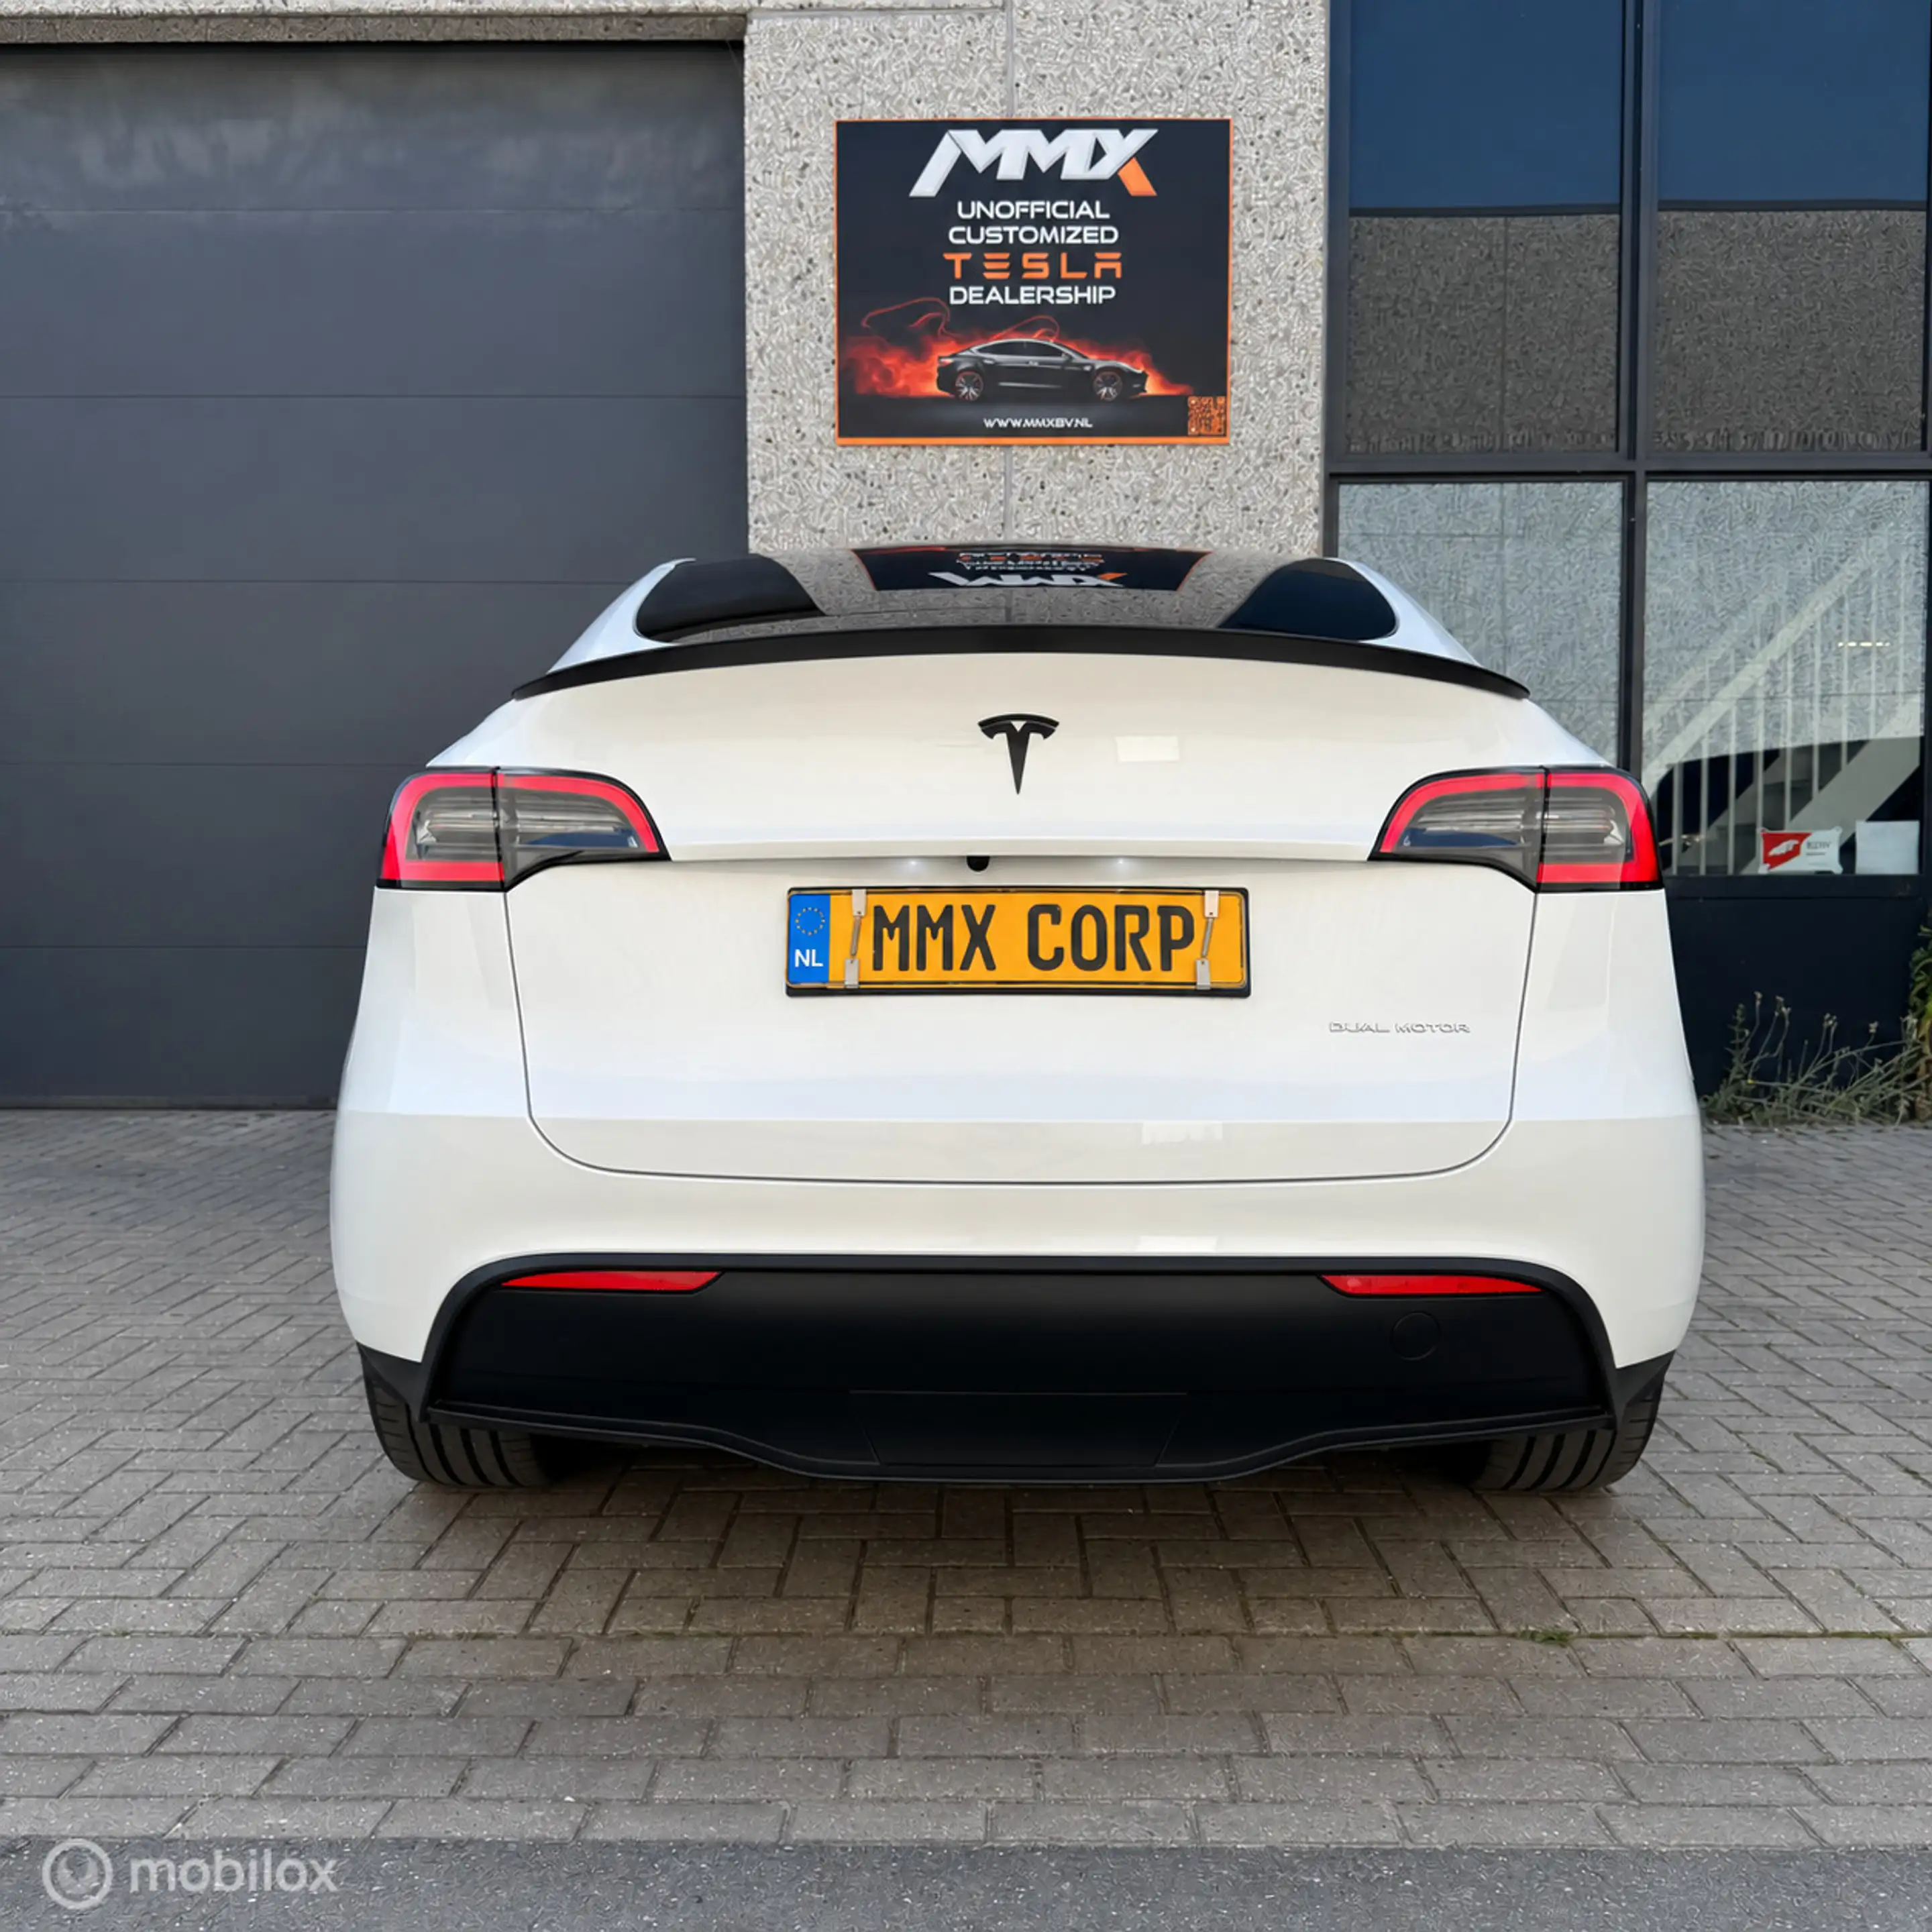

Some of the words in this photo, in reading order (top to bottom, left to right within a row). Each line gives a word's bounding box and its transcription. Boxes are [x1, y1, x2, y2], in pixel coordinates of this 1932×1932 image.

[909, 129, 1159, 197] MMX
[957, 201, 1110, 219] UNOFFICIAL
[948, 226, 1119, 244] CUSTOMIZED
[943, 252, 1122, 279] TESLA
[949, 286, 1116, 305] DEALERSHIP
[873, 904, 996, 971] MMX
[1027, 904, 1195, 971] CORP
[795, 949, 824, 968] NL
[1330, 1022, 1390, 1033] DUAL
[1395, 1022, 1470, 1033] MOTOR
